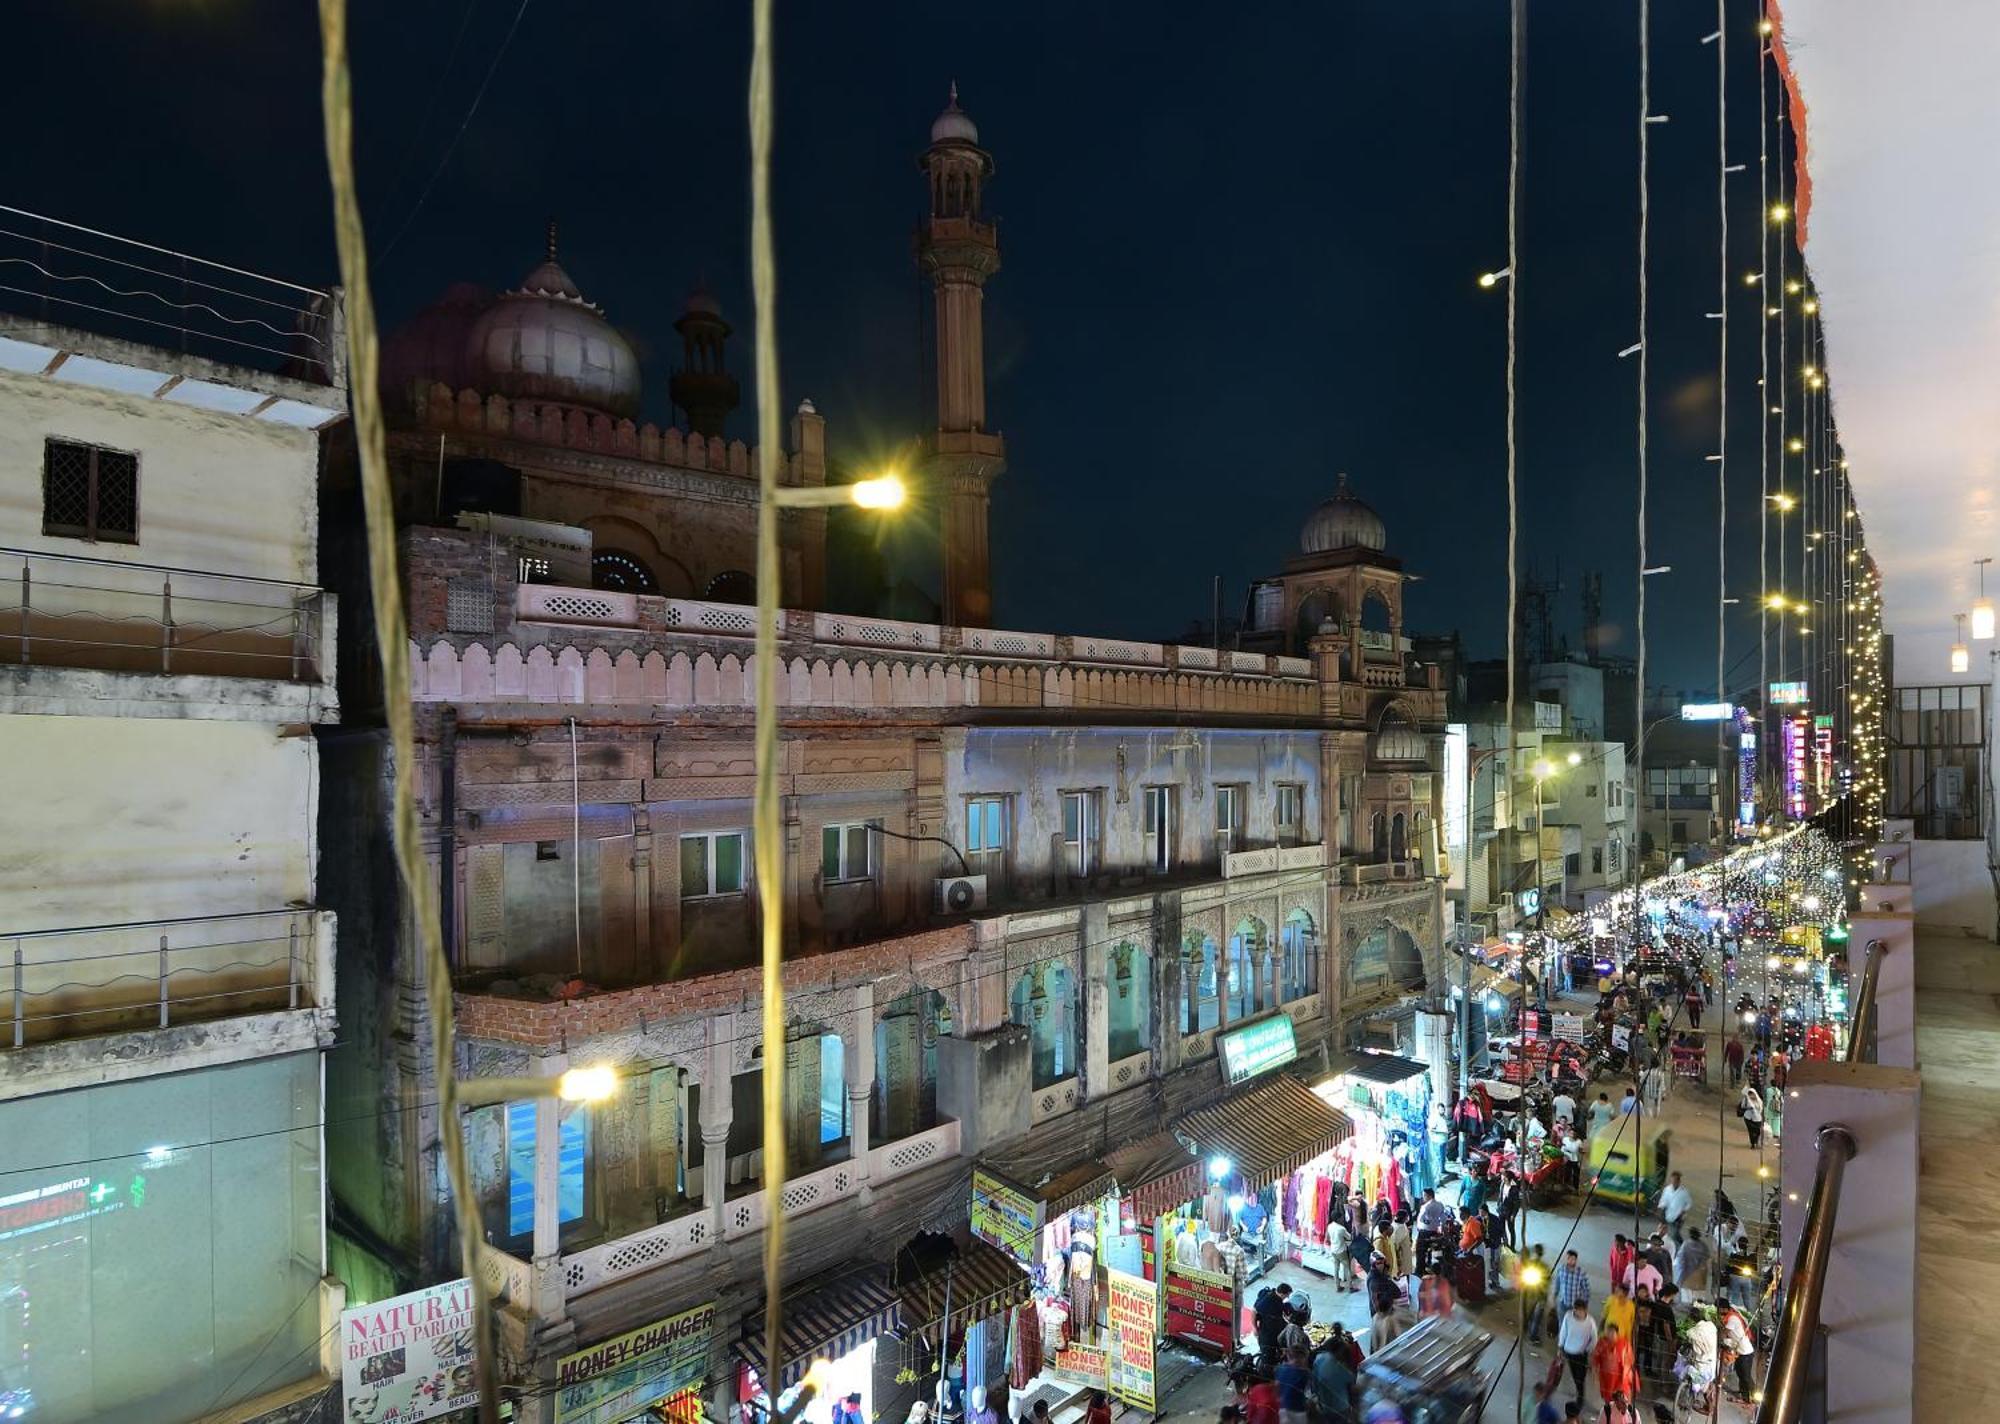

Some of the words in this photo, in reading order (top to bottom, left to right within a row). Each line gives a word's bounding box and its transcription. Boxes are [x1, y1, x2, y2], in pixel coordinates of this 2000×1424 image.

[1111, 1290, 1154, 1319] MONEY
[1111, 1308, 1154, 1332] CHANGER
[348, 1331, 408, 1361] BEAUTY
[560, 1340, 630, 1387] MONEY
[632, 1308, 714, 1358] CHANGER
[1121, 1324, 1150, 1349] MONEY
[1058, 1350, 1105, 1367] MONEY
[1058, 1360, 1106, 1377] CHANGER
[1122, 1343, 1152, 1370] CHANGER
[373, 1379, 394, 1391] HAIR
[401, 1410, 424, 1424] OVER
